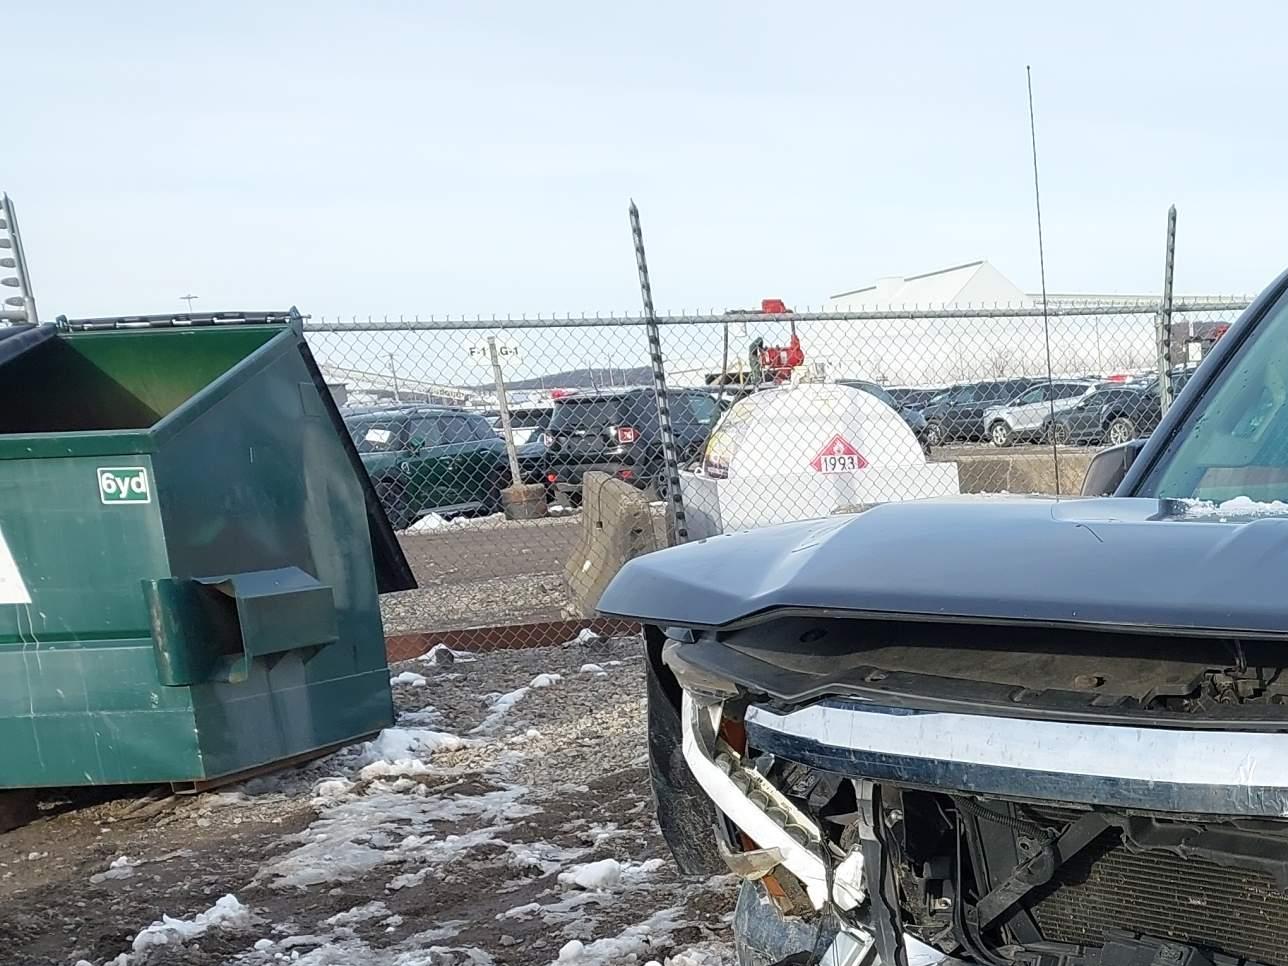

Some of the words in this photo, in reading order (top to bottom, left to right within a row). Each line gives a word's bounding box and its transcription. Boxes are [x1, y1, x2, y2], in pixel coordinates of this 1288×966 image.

[469, 347, 486, 356] F-1
[500, 346, 518, 356] G-1
[823, 456, 856, 472] 1993
[101, 471, 146, 499] 6yd
